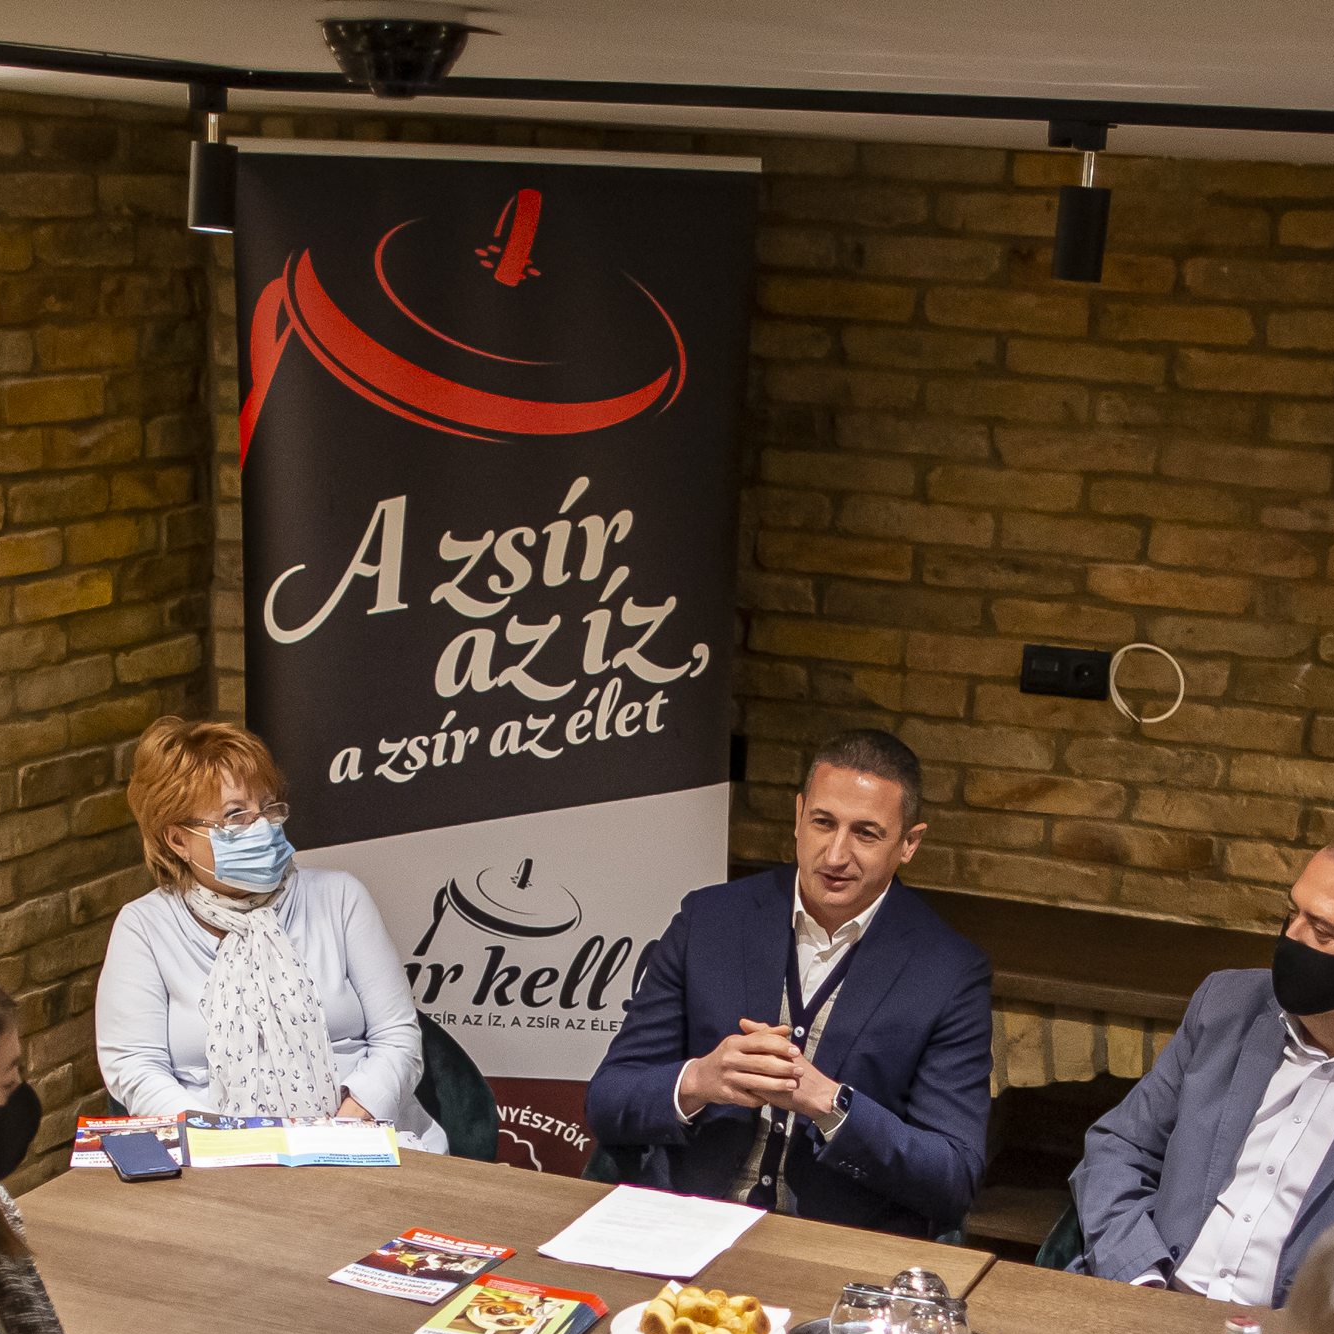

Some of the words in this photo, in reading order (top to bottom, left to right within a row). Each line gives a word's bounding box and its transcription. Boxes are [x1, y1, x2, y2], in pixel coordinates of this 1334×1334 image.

[264, 494, 408, 644] A
[430, 476, 633, 618] zsír
[435, 614, 576, 701] az
[582, 566, 709, 684] íz,
[328, 747, 364, 784] a
[374, 710, 479, 783] zsír
[489, 713, 564, 760] az
[566, 677, 669, 745] élet
[462, 1014, 483, 1026] AZ
[488, 1012, 506, 1028] ÍZ,
[511, 1016, 522, 1027] A
[526, 1014, 560, 1029] ZSÍR
[565, 1018, 585, 1030] AZ
